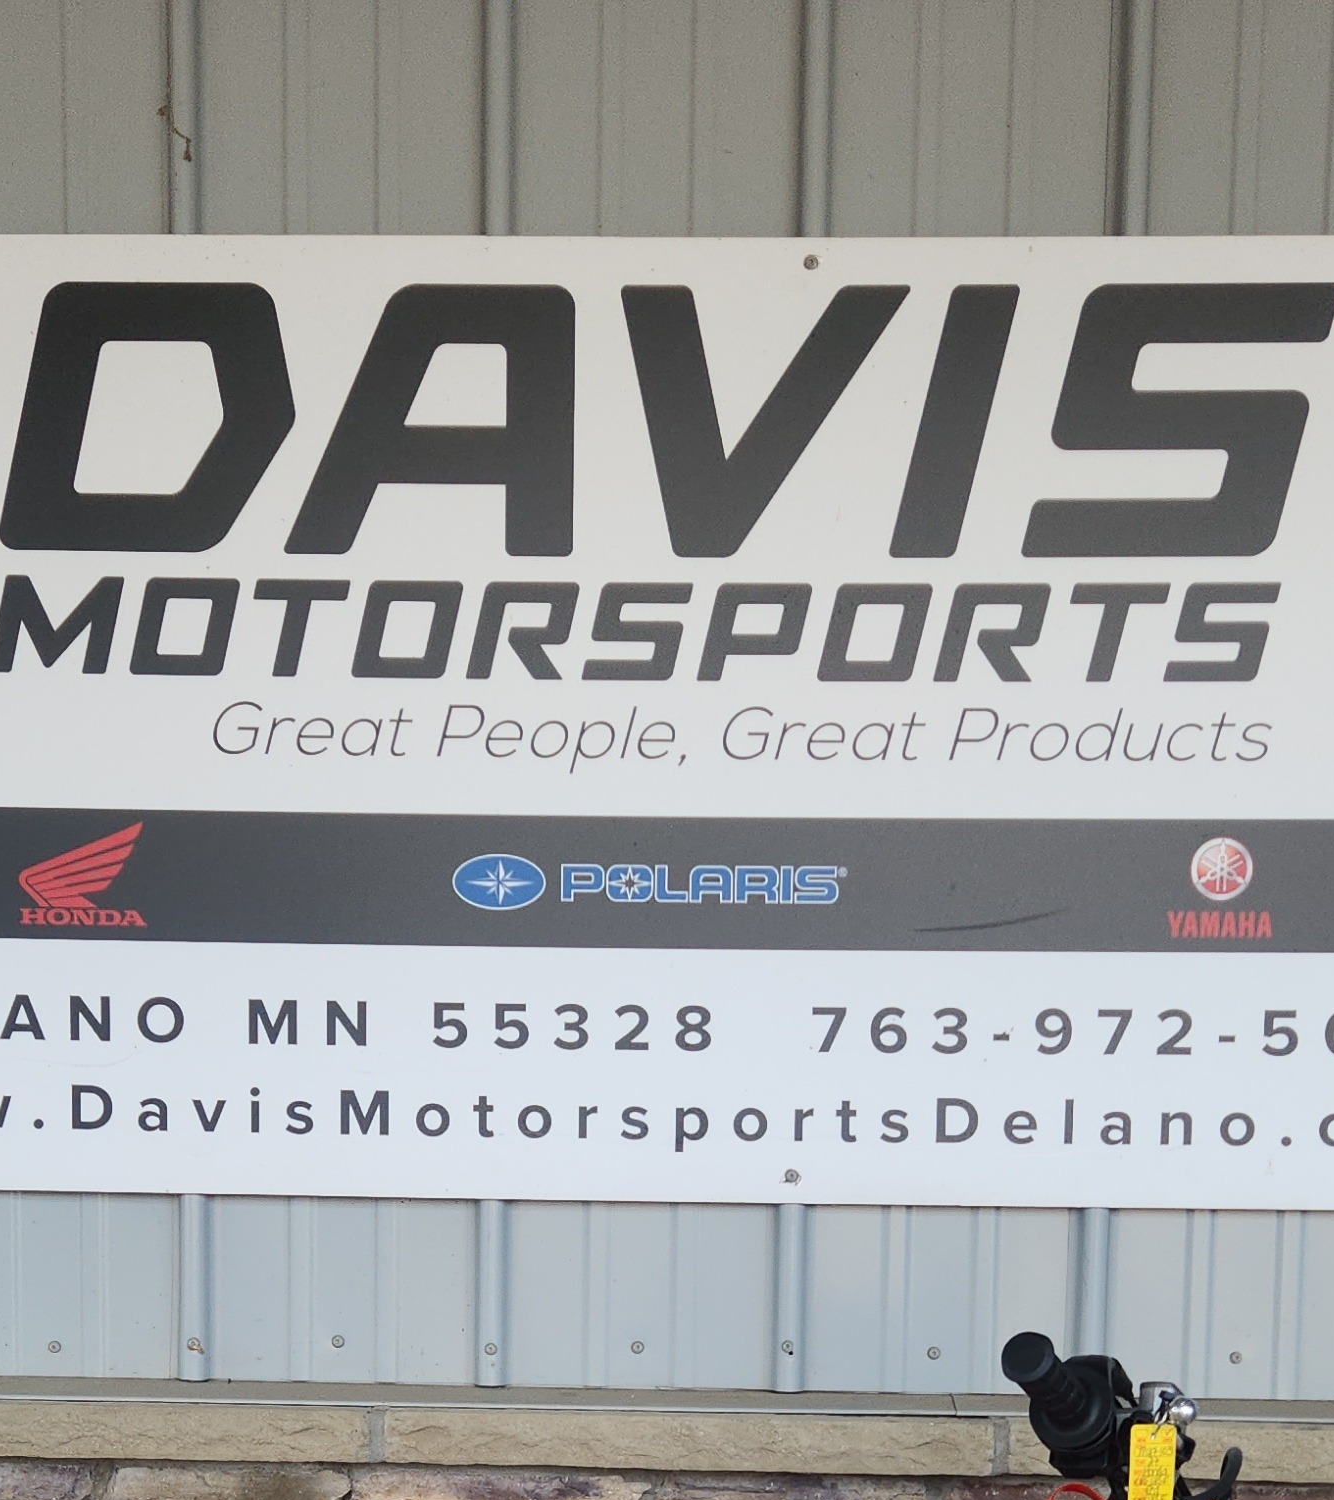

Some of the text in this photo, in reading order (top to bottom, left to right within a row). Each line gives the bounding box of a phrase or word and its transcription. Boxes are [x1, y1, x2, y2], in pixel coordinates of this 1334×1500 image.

[212, 700, 1273, 775] Great People, Great Products
[19, 907, 148, 928] HONDA
[1167, 909, 1273, 938] YAMAHA
[248, 999, 368, 1047] MN
[433, 1002, 713, 1052] 55328
